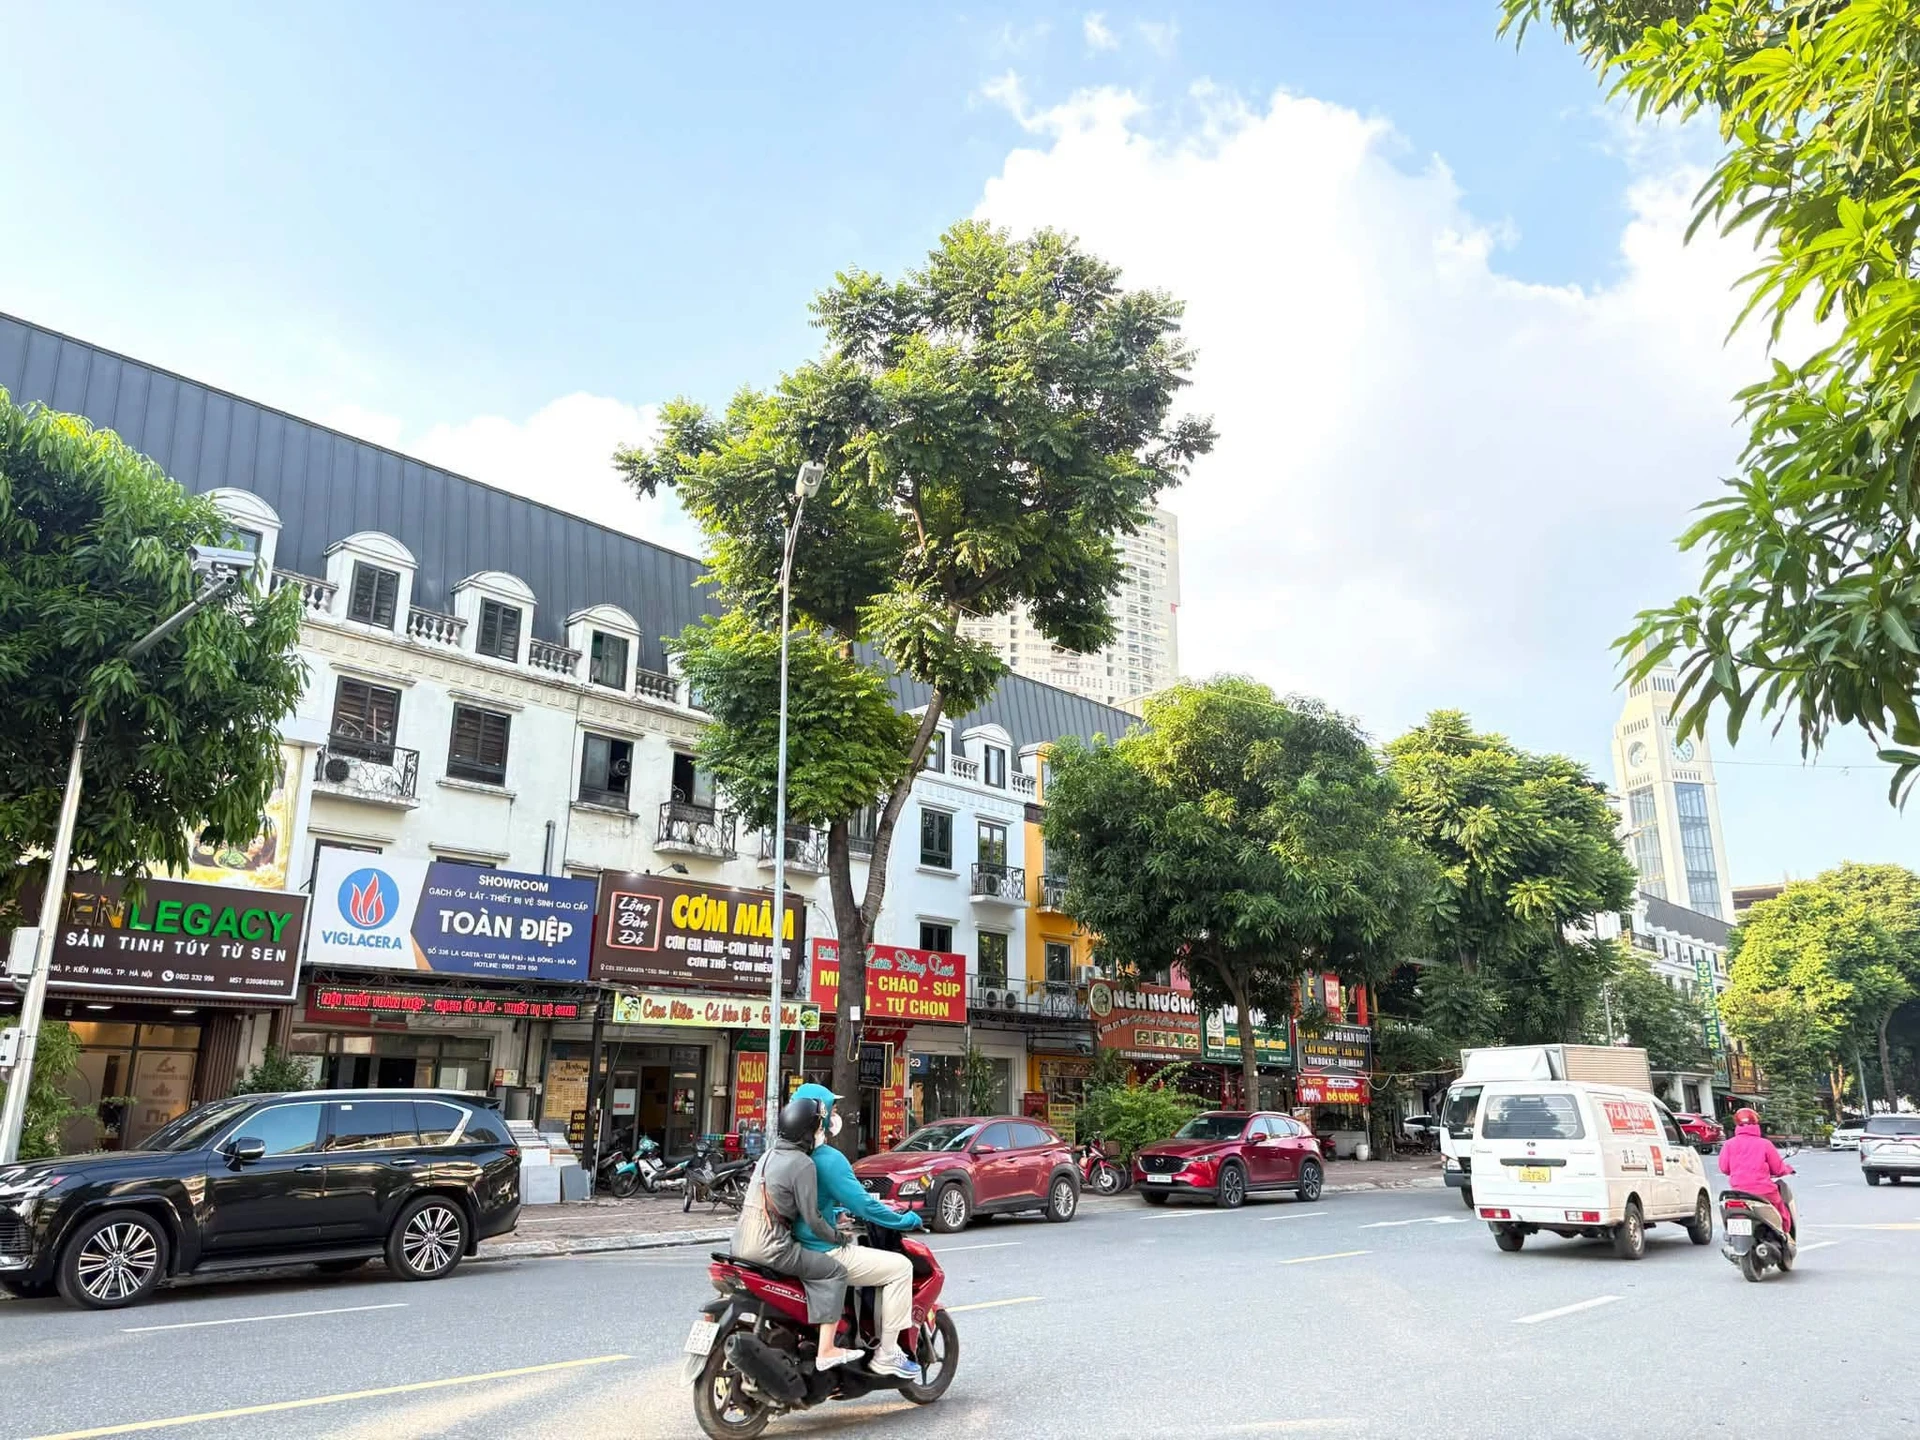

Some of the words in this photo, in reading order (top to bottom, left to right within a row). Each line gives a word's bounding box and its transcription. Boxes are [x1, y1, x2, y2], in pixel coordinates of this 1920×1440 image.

[478, 874, 549, 893] SHOWROOM
[428, 887, 452, 897] GẠCH
[454, 888, 467, 898] ỐP
[470, 891, 485, 900] LÁT
[537, 899, 554, 908] SINH
[556, 901, 572, 910] CAO
[573, 900, 589, 911] CẤP
[618, 896, 652, 916] Lồng
[128, 898, 293, 943] LEGACY
[439, 907, 513, 939] TOÀN
[519, 915, 573, 947] ĐIỆP
[618, 911, 649, 928] Bàn
[671, 893, 728, 933] CƠM
[732, 900, 794, 941] MÂM
[65, 928, 105, 948] SẢN
[119, 936, 165, 954] TINH
[174, 938, 210, 957] TÚY
[220, 943, 244, 959] TỪ
[251, 947, 287, 962] SEN
[321, 930, 402, 950] VIGLACERA
[617, 929, 645, 945] Đỏ
[664, 935, 686, 950] CƠM
[687, 937, 702, 952] GIA
[728, 942, 747, 956] CƠM
[461, 950, 480, 958] CASTA
[686, 956, 708, 968] CƠM
[732, 961, 753, 972] CƠM
[73, 964, 89, 974] KIẾN
[129, 969, 138, 977] HÀ
[878, 974, 919, 994] CHÁO
[932, 979, 961, 998] SÚP
[463, 998, 476, 1013] ỐP
[478, 1000, 496, 1013] LÁT
[885, 996, 908, 1016] TỰ
[909, 999, 949, 1020] CHỌN
[1112, 989, 1147, 1010] NEM
[704, 1001, 720, 1022] Cá
[761, 1005, 772, 1023] G
[739, 1055, 765, 1083] CHÁO
[1302, 1087, 1321, 1102] 100%
[1326, 1088, 1338, 1101] ĐỒ
[1338, 1088, 1360, 1102] UỐNG
